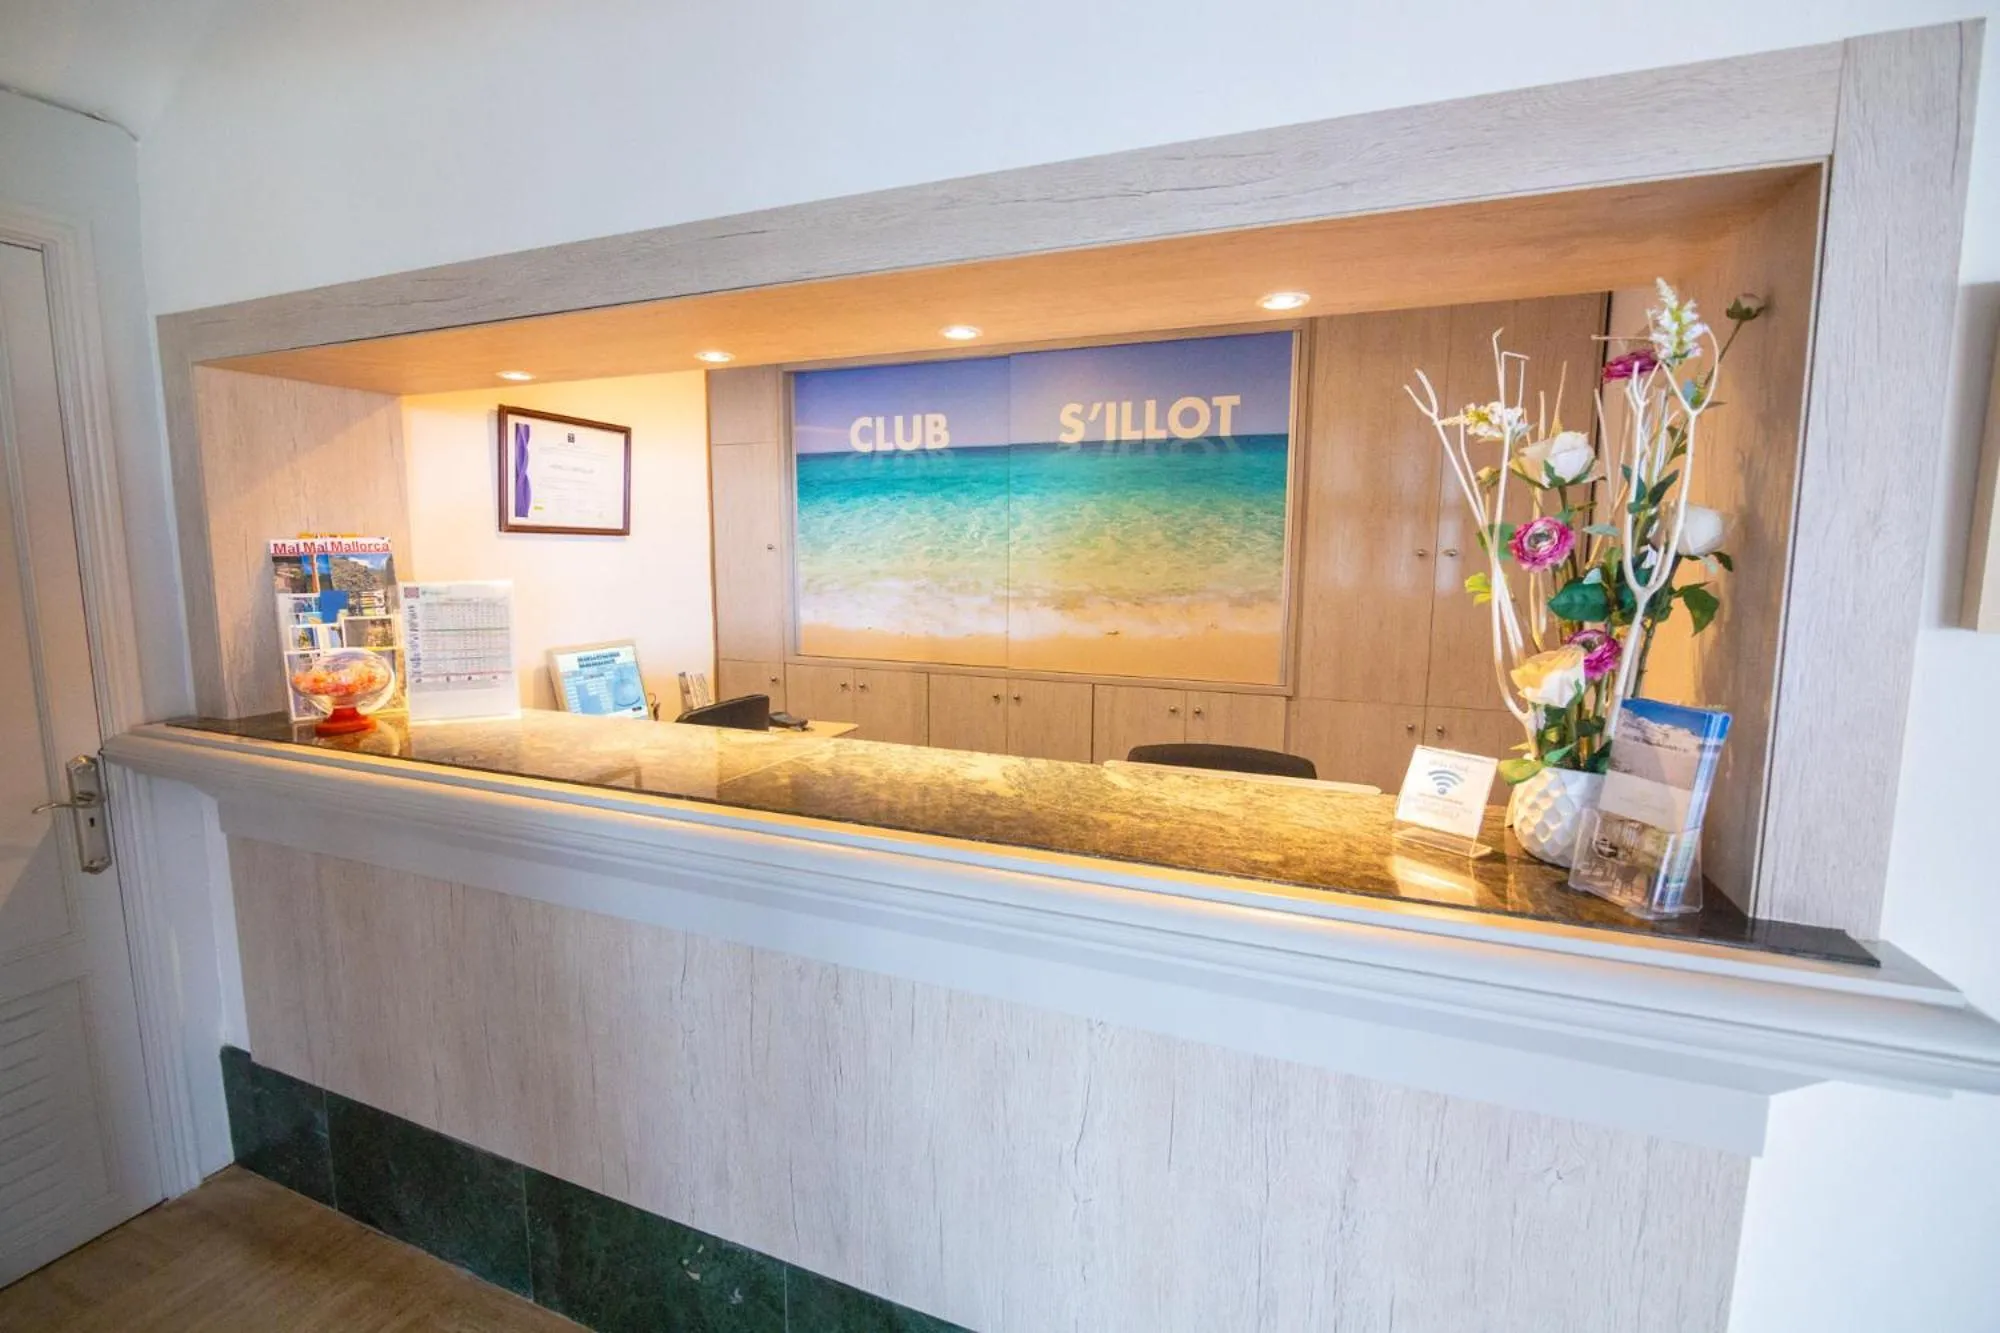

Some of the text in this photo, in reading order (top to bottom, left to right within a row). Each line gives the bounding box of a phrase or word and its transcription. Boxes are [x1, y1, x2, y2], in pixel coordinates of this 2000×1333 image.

[850, 394, 1242, 453] CLUB S'ILLOT
[331, 540, 390, 553] Mallorca
